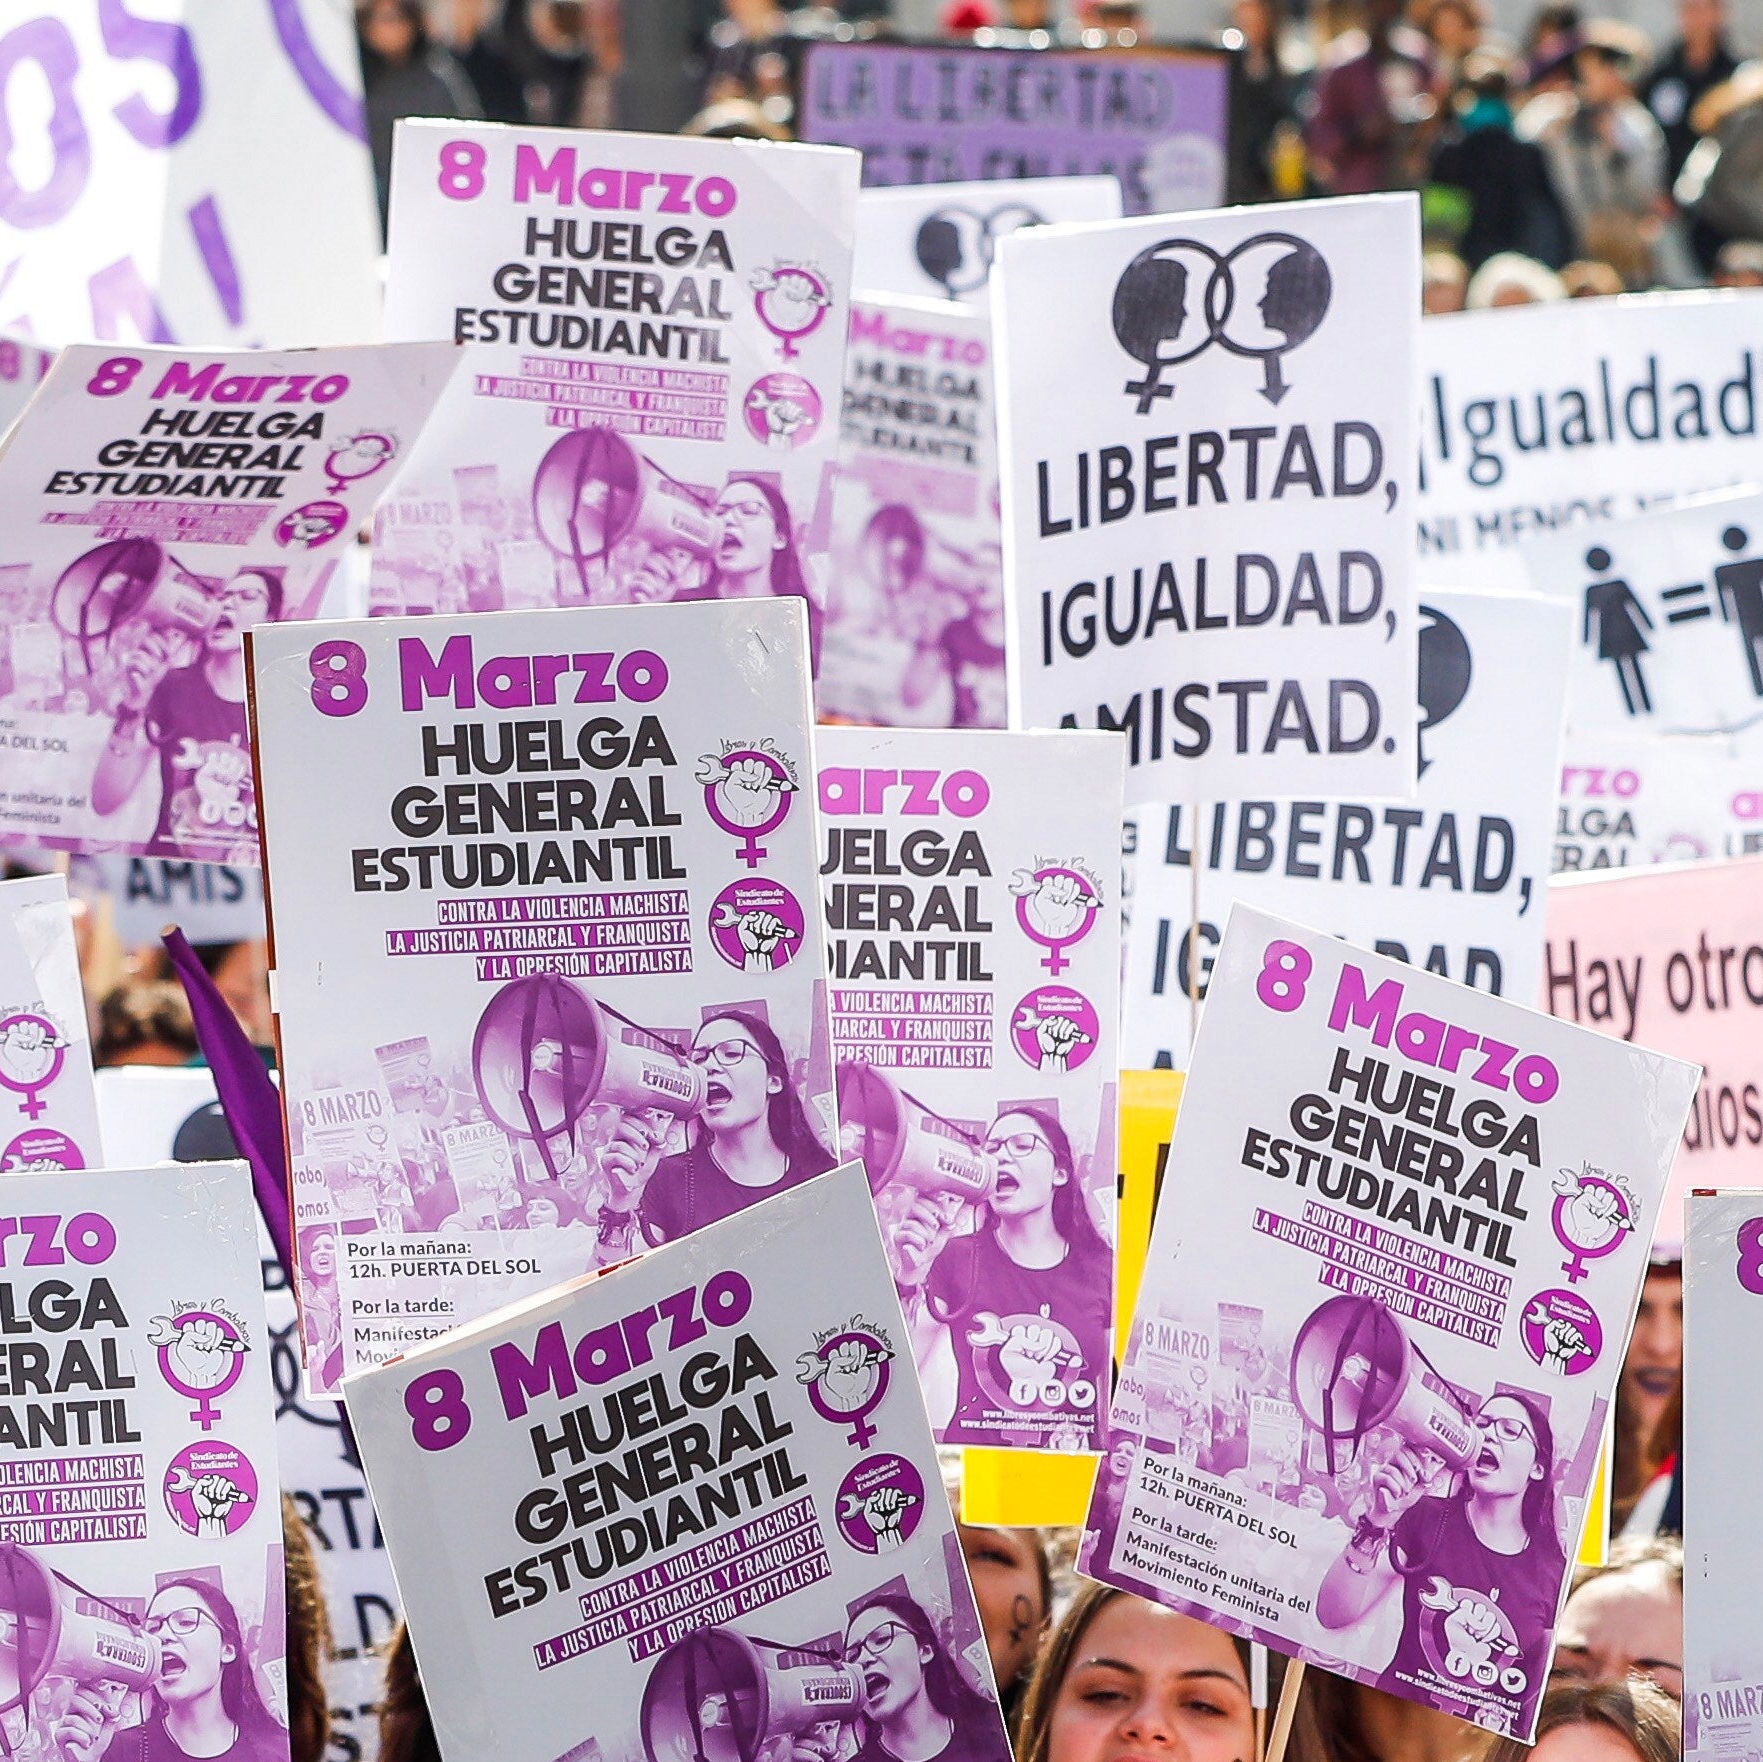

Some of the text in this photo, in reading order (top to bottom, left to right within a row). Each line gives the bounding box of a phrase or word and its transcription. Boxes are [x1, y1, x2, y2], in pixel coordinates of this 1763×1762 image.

[814, 54, 1176, 132] LA LIBERTAD
[437, 138, 738, 219] 8 Marzo
[524, 213, 736, 272] HUELGA
[491, 260, 734, 322] GENERAL
[453, 303, 732, 364] ESTUDIANTIL
[86, 356, 350, 406] 8 Marzo
[95, 438, 305, 472] GENERAL
[139, 407, 326, 441] HUELGA
[43, 470, 287, 501] ESTUDIANTIL
[1037, 420, 1398, 539] LIBERTAD,
[1039, 549, 1398, 667] IGUALDAD,
[308, 634, 670, 717] 8 Marzo
[421, 714, 678, 778] HUELGA
[390, 774, 683, 839] GENERAL
[350, 835, 688, 893] ESTUDIANTIL
[1165, 799, 1534, 918] LIBERTAD,
[387, 922, 691, 954] LA JUSTICIA PATRIARCAL Y FRANQUISTA
[919, 993, 993, 1014] MACHISTA
[1253, 941, 1310, 1014] 8
[1328, 963, 1559, 1105] Marzo
[1544, 936, 1643, 1042] Hay
[905, 1020, 993, 1044] FRANQUISTA
[1327, 1046, 1540, 1168] HUELGA
[1239, 1126, 1519, 1268] ESTUDIANTIL
[1288, 1092, 1529, 1221] GENERAL
[1318, 1263, 1501, 1349] Y LA OPRESIÓN CAPITALISTA
[405, 1271, 754, 1453] 8 Marzo
[528, 1334, 780, 1478] HUELGA
[515, 1392, 797, 1545] GENERAL
[484, 1448, 811, 1620] ESTUDIANTIL
